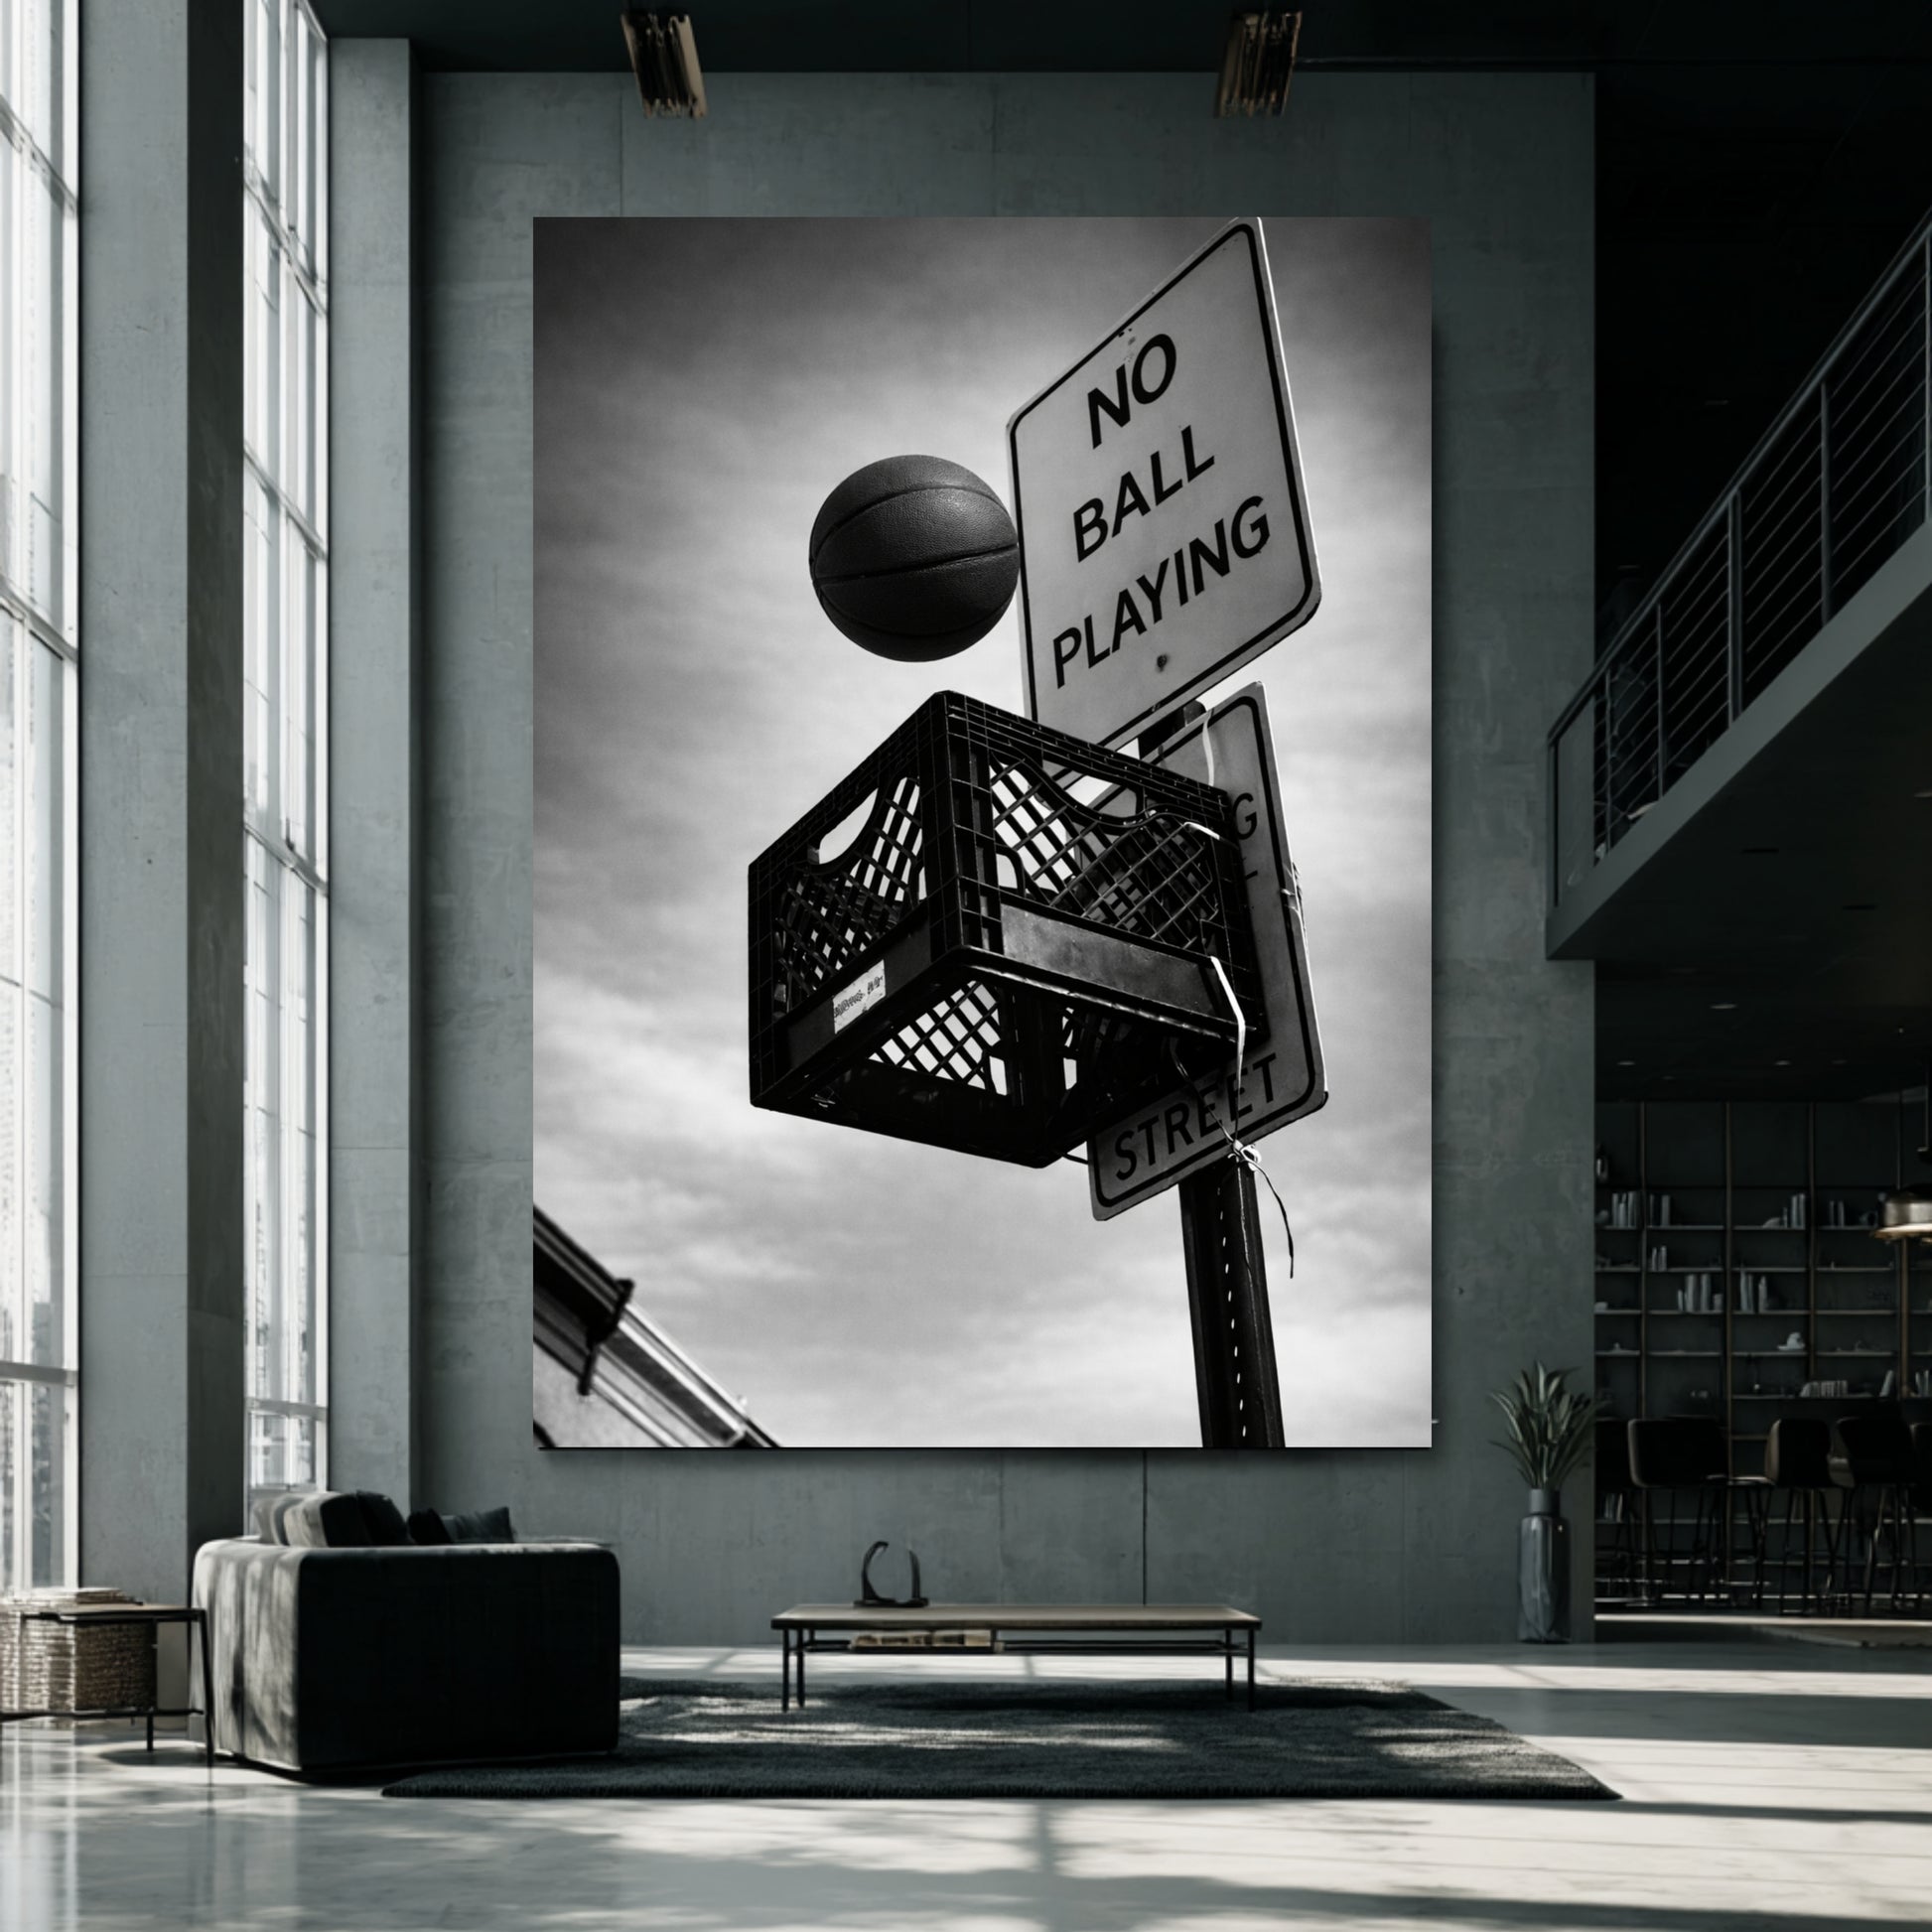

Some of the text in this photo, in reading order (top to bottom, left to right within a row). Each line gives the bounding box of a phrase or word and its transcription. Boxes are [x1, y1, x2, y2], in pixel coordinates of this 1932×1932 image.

[1087, 334, 1177, 449] NO
[1073, 425, 1215, 563] BALL
[1052, 495, 1271, 689] PLAYING
[1115, 1053, 1276, 1180] STREET
